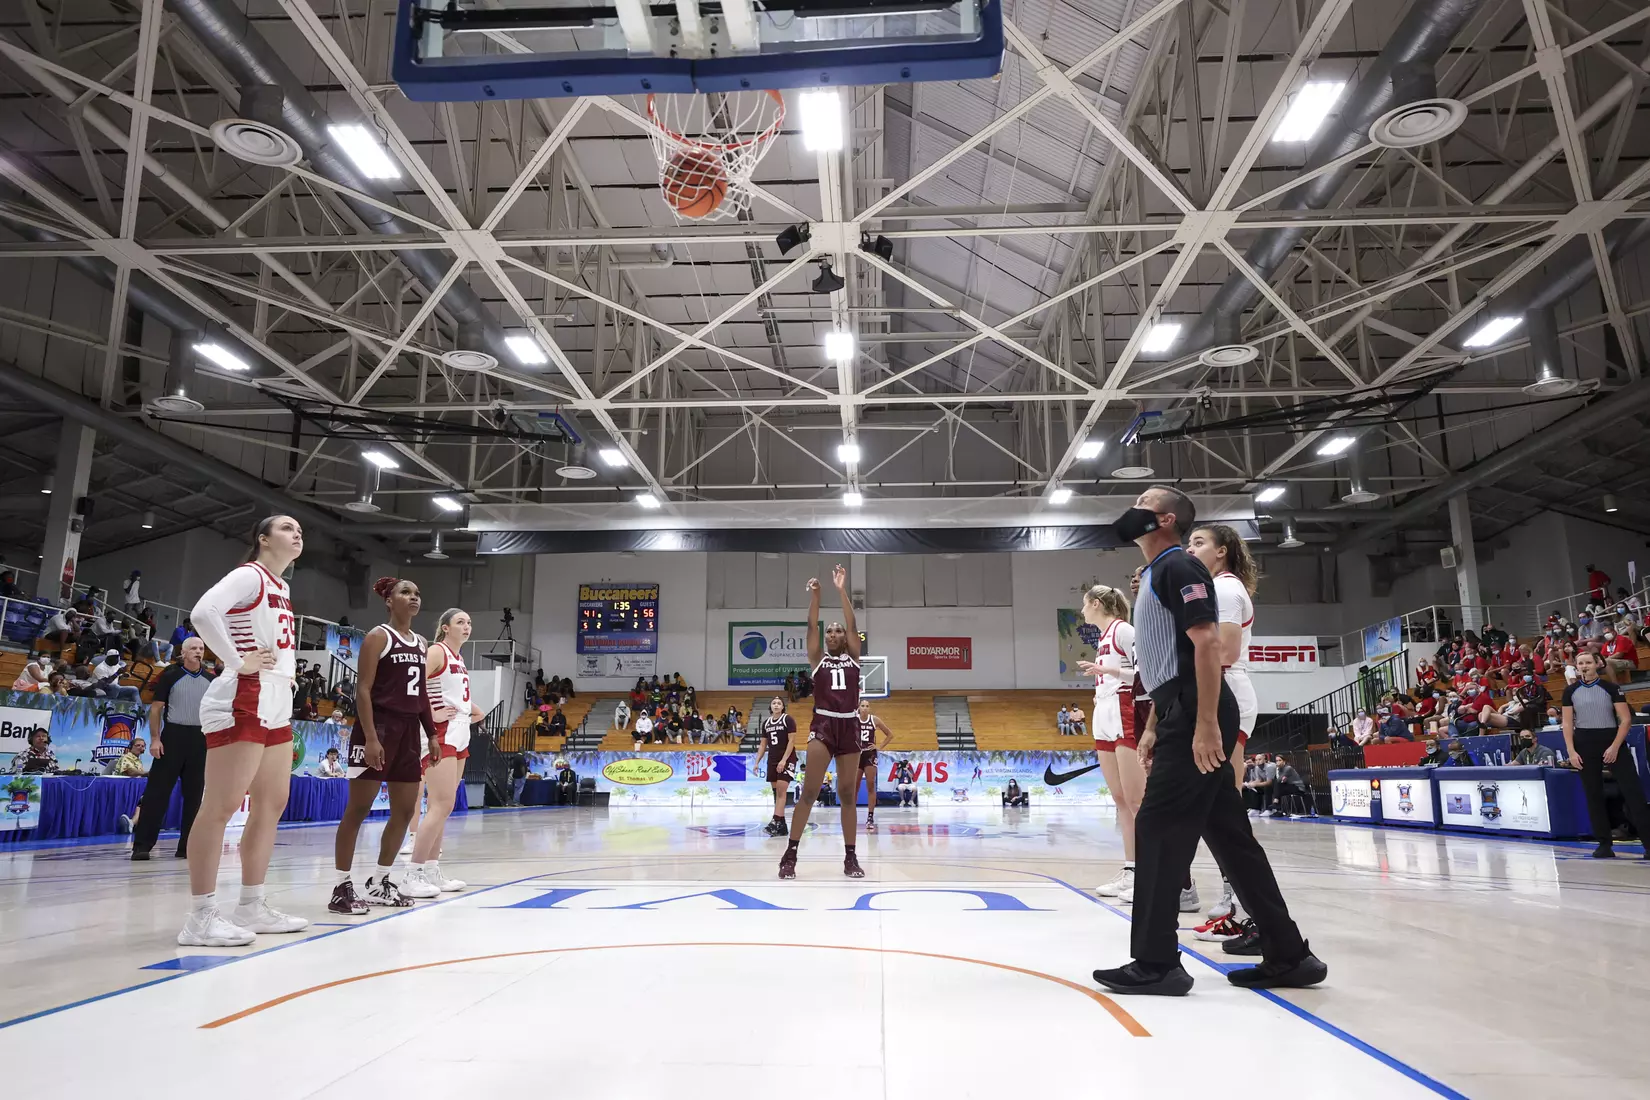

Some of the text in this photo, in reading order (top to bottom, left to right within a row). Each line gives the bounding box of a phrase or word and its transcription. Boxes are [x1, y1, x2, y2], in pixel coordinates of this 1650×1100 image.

[580, 587, 657, 600] Buccaneers
[614, 602, 630, 610] 1:35
[643, 609, 654, 617] 56
[909, 646, 960, 656] BODYARMOR
[1248, 645, 1316, 663] ESPN
[391, 653, 419, 664] TEXAS
[751, 667, 776, 675] sponsor
[407, 666, 420, 696] 2
[830, 668, 847, 690] 11
[770, 731, 778, 745] 5
[96, 746, 126, 758] PARADISE
[635, 766, 651, 774] Real
